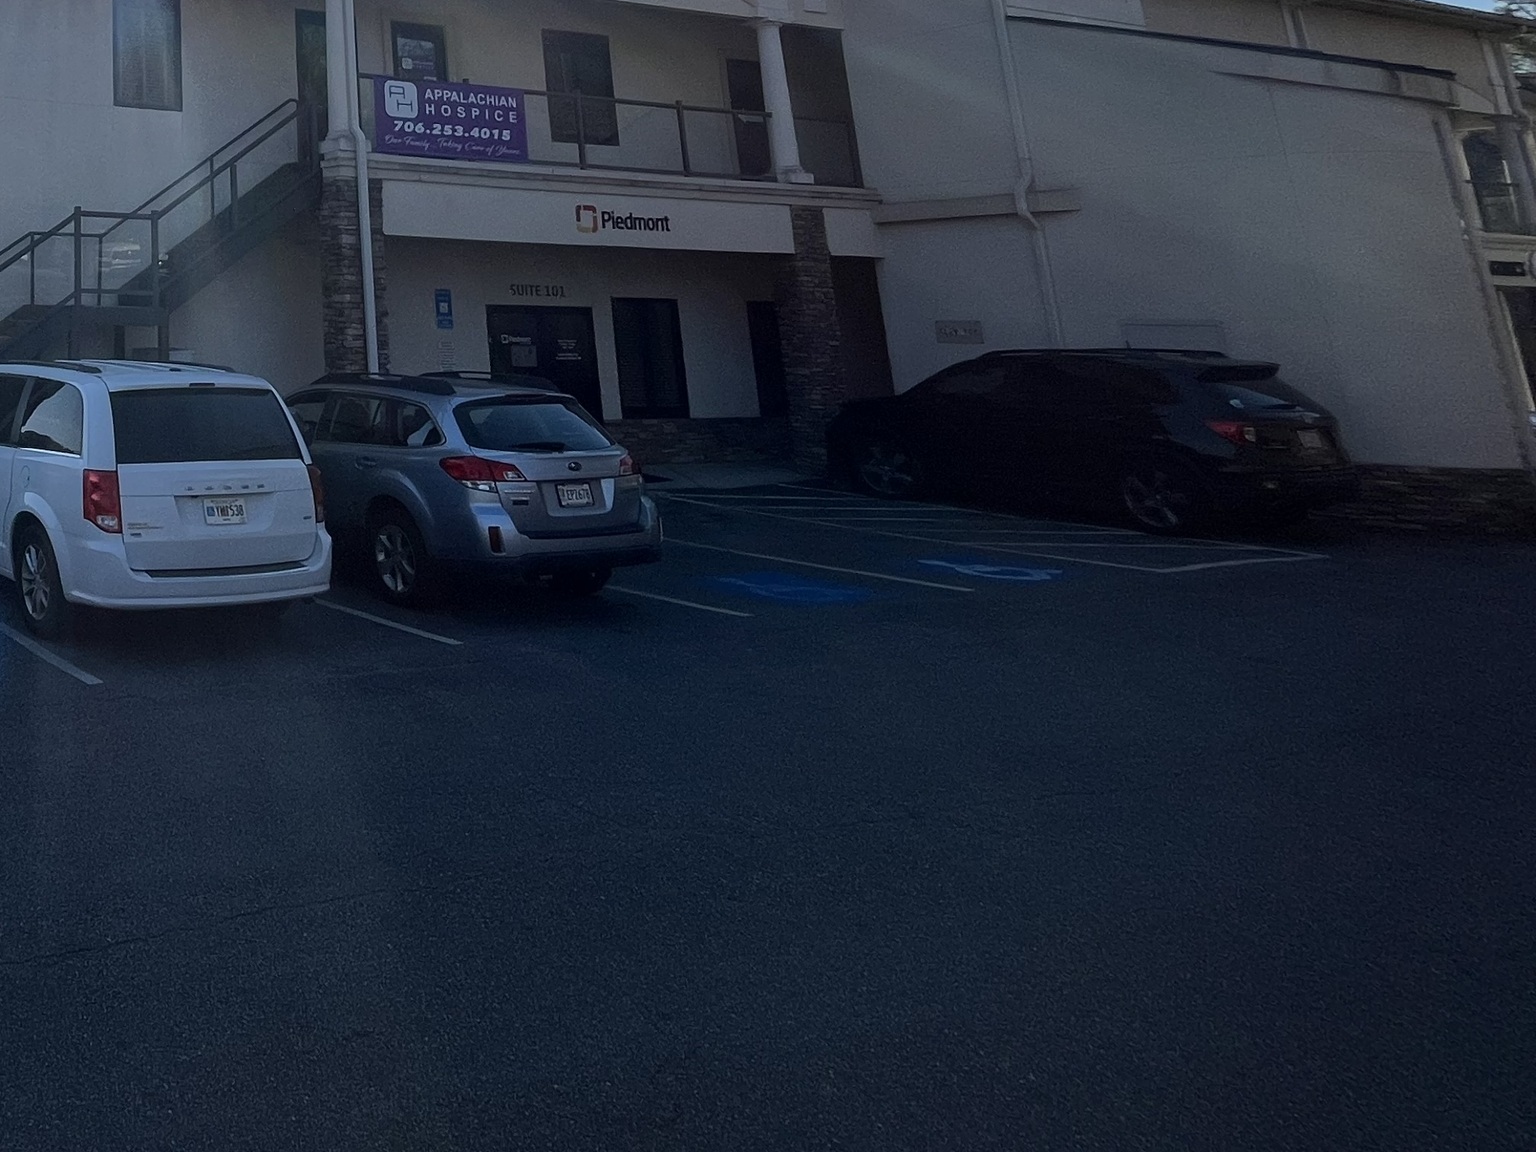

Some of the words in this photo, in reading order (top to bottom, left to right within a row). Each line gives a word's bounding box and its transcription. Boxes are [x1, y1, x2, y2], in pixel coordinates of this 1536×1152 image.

[425, 88, 517, 108] APPALACHIAN
[425, 103, 518, 123] HOSPICE
[393, 120, 511, 141] 706.253.4015
[437, 137, 462, 152] Taking
[484, 144, 494, 156] of
[601, 210, 671, 232] Piedmont
[509, 284, 542, 296] SUITE
[545, 285, 566, 298] 101
